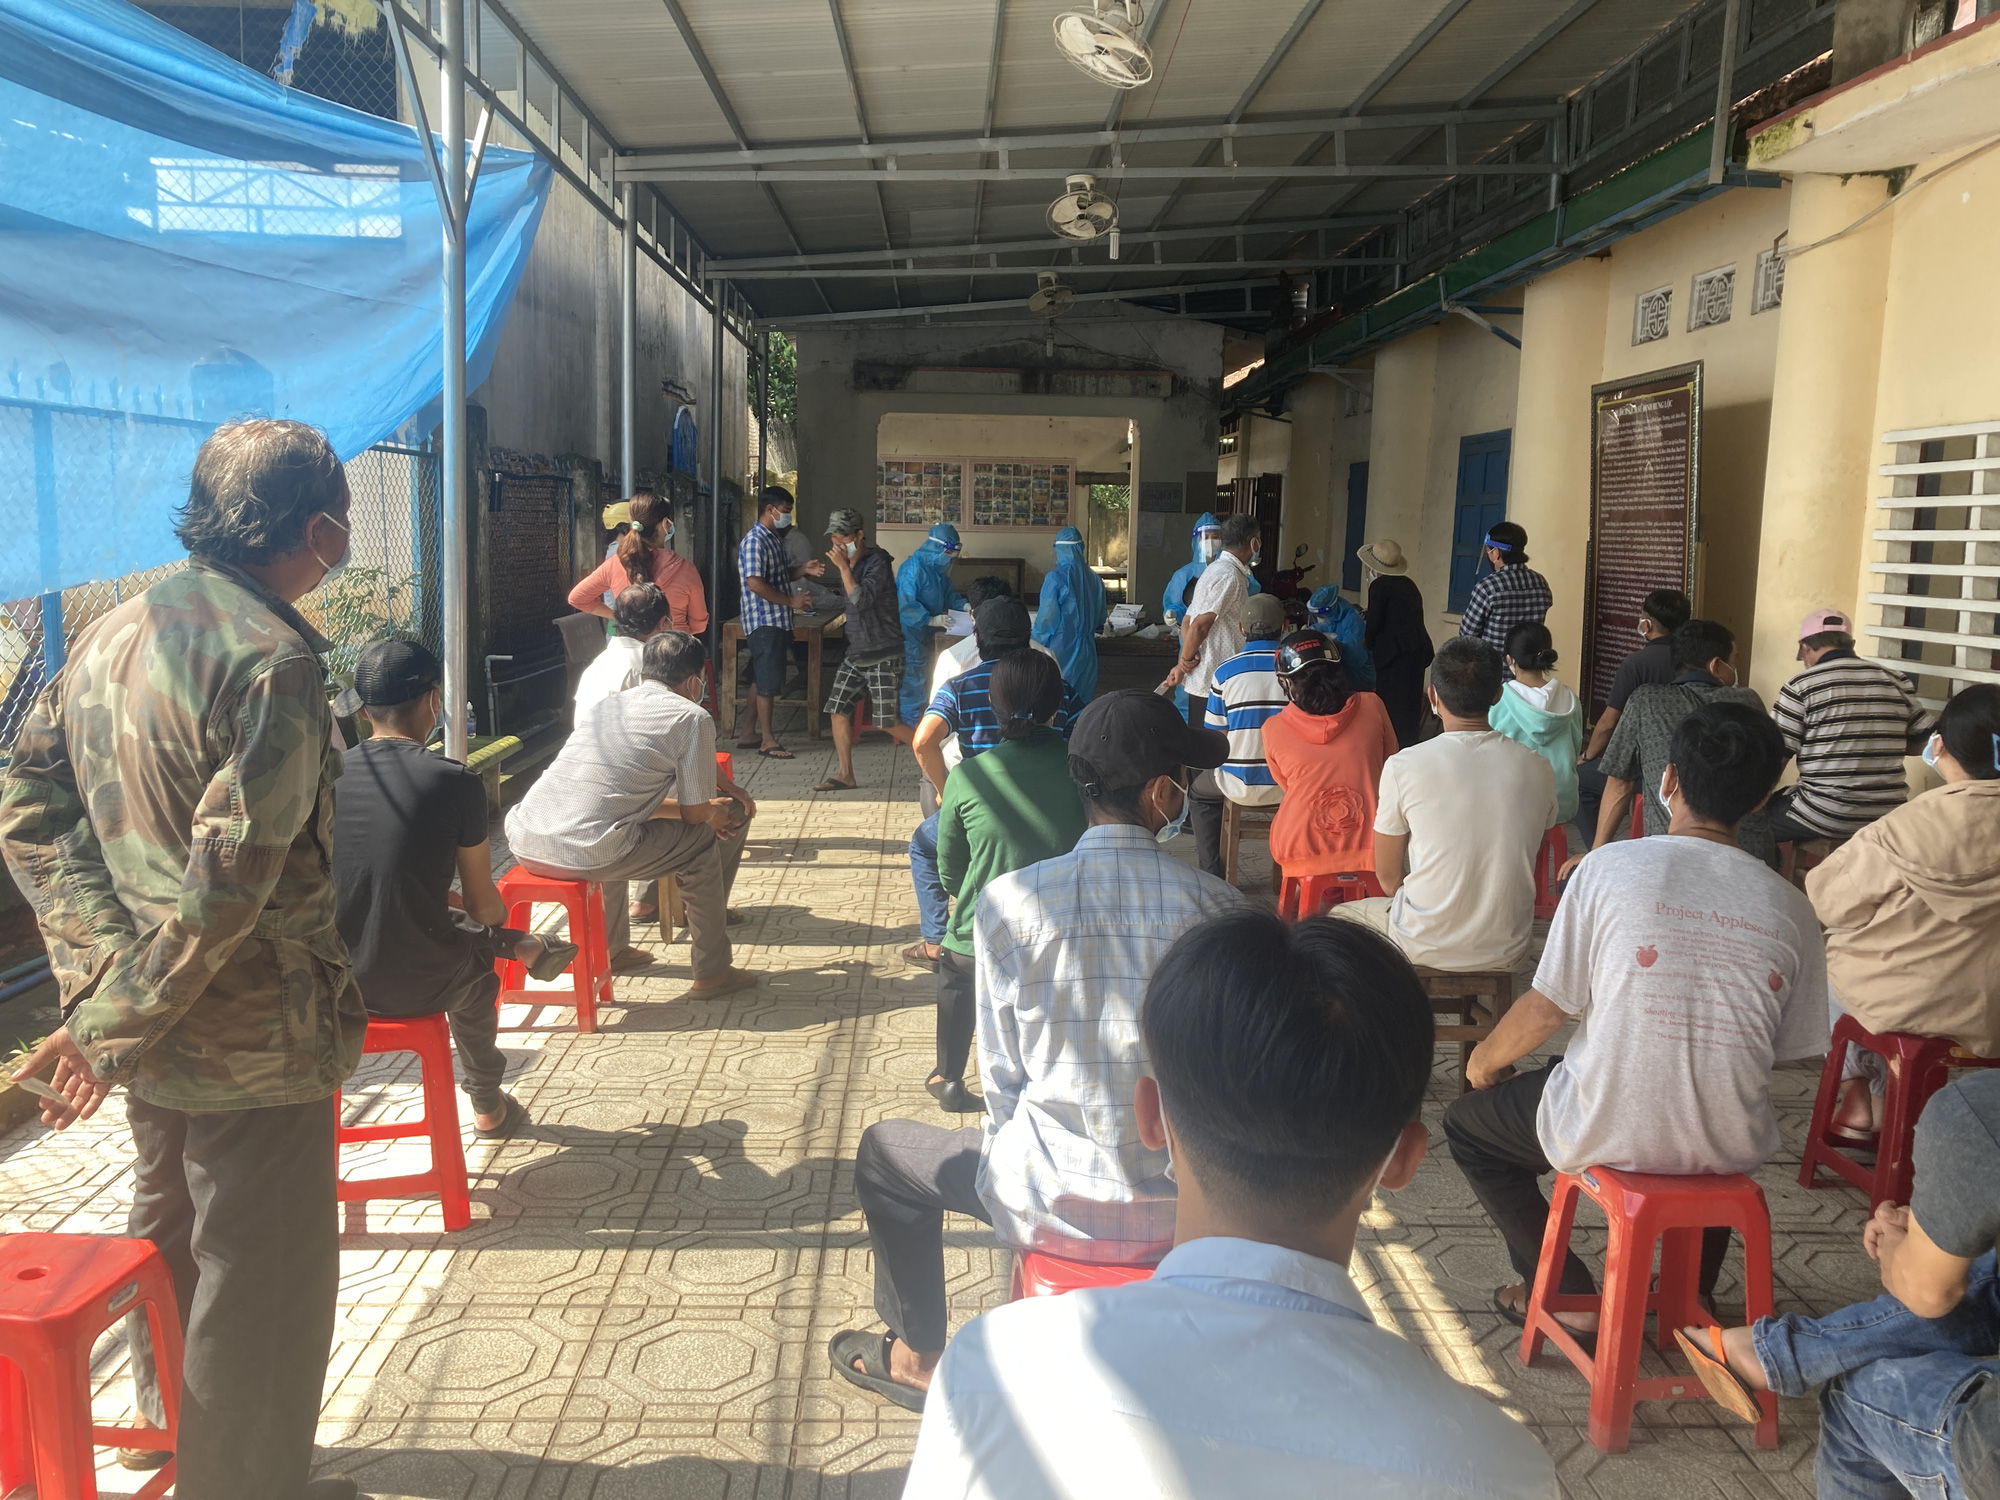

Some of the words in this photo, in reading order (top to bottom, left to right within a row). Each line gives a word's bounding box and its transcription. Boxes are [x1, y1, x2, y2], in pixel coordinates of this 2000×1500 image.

[1655, 901, 1704, 920] Project
[1708, 910, 1779, 940] Appleseed
[1643, 1007, 1676, 1019] Shooting
